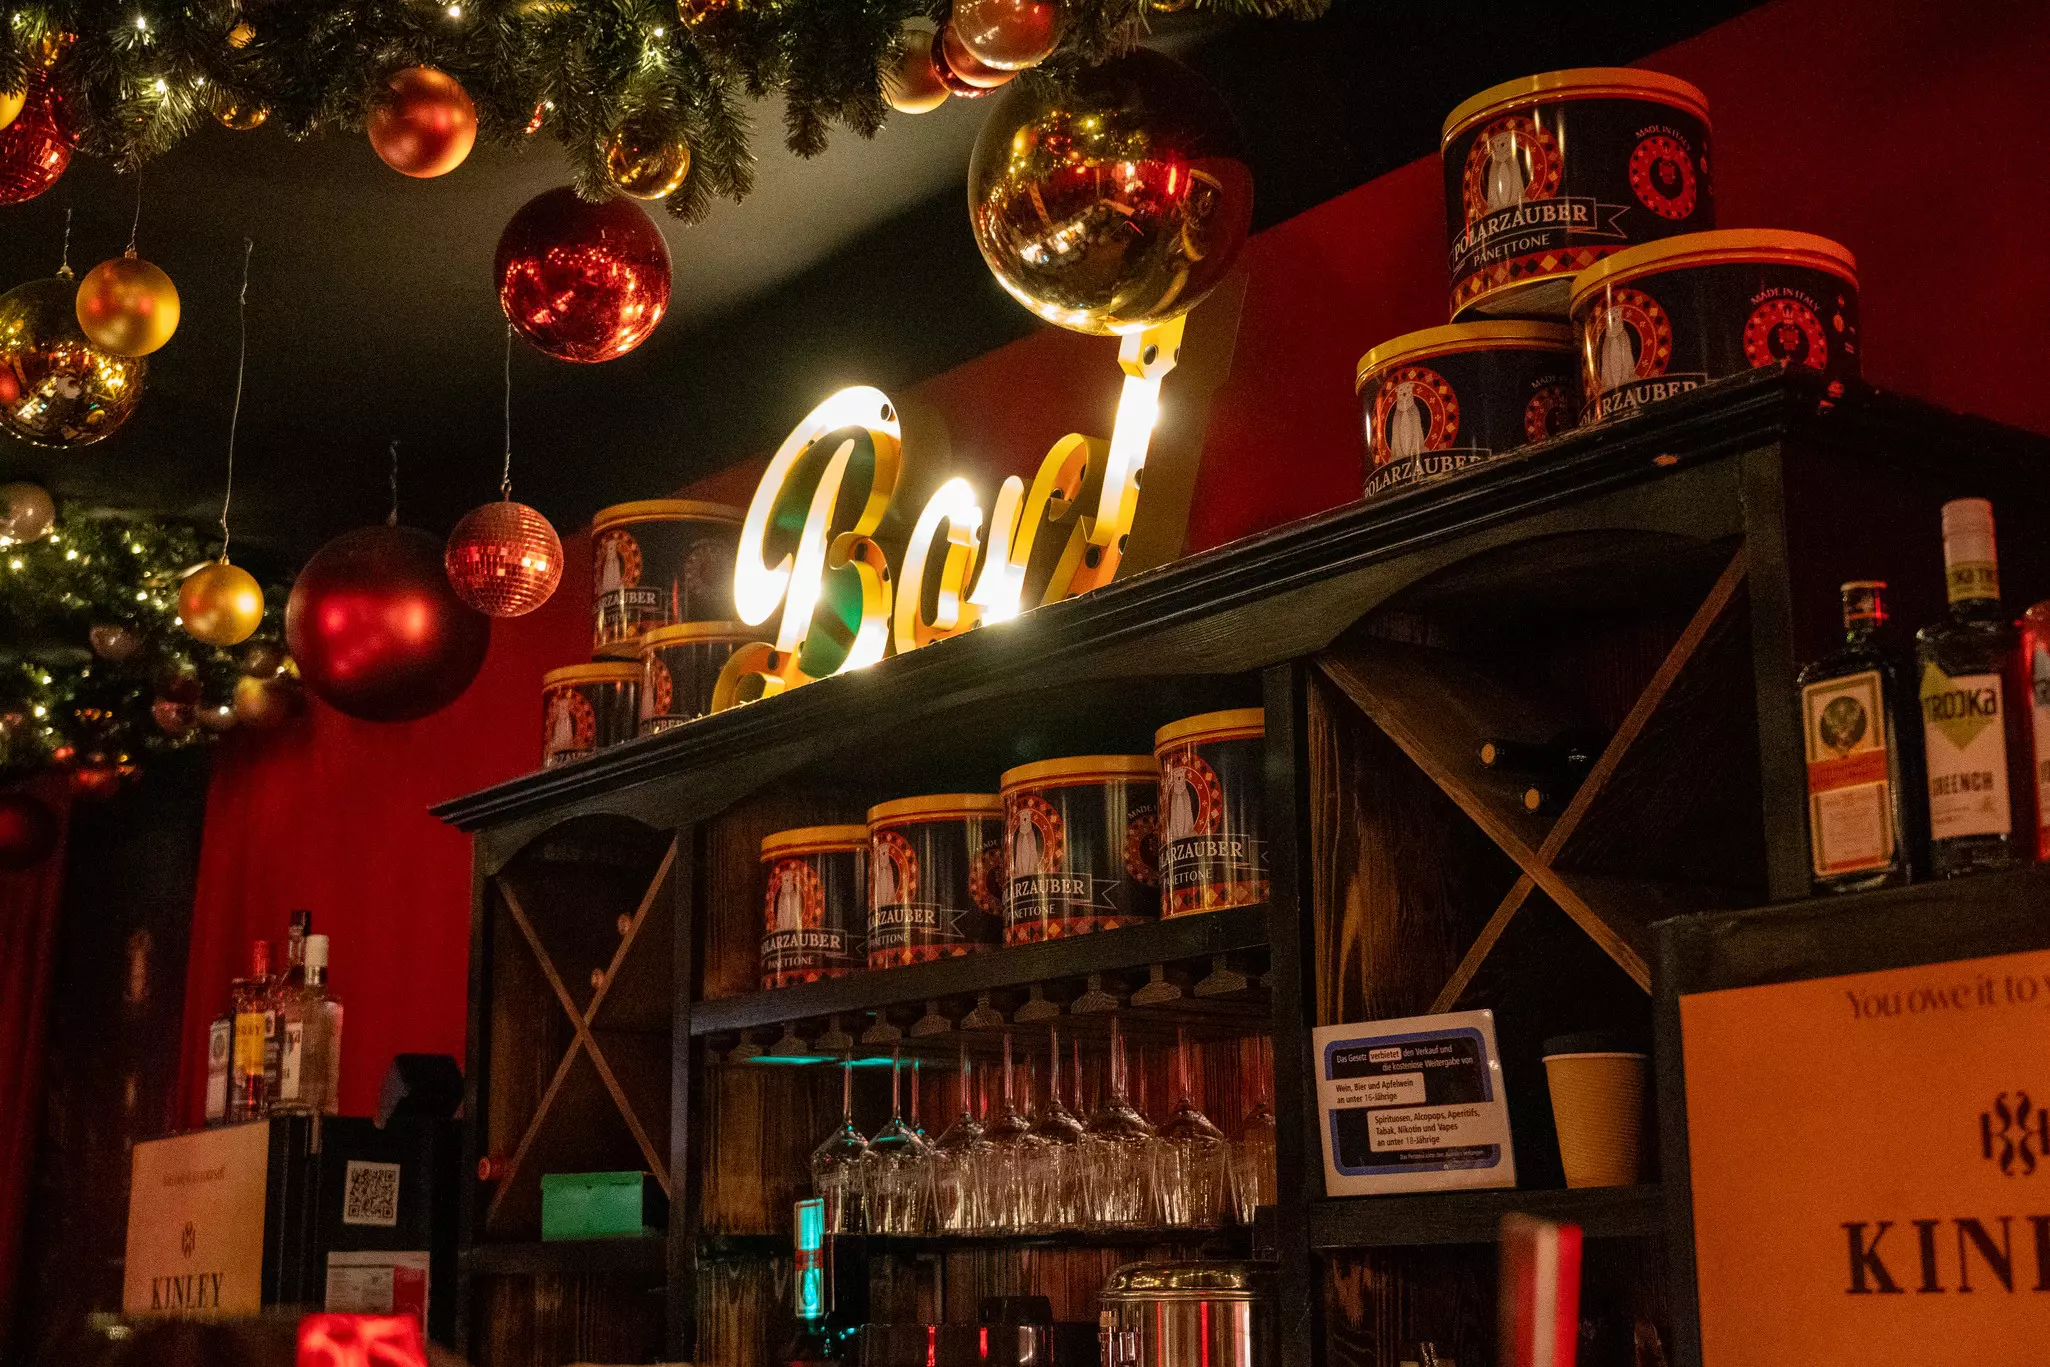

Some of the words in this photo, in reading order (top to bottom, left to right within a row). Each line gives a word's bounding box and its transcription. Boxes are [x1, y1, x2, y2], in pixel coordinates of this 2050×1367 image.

[1453, 203, 1588, 261] POLARZAUBER
[1473, 233, 1551, 266] PANETTONE
[1750, 288, 1779, 305] MADE
[1782, 287, 1794, 297] IN
[1794, 290, 1821, 313] ITALY
[1127, 804, 1154, 819] MADE
[1847, 988, 1902, 1019] You
[1906, 984, 1971, 1014] owe
[1974, 973, 1999, 1006] it
[2006, 974, 2039, 1004] to
[1336, 1055, 1347, 1064] Das
[1348, 1053, 1367, 1063] Gesetz
[1370, 1050, 1400, 1060] verbietet
[1402, 1047, 1414, 1057] den
[1415, 1044, 1439, 1056] Verkauf
[1440, 1044, 1453, 1053] und
[1382, 1062, 1392, 1072] die
[1392, 1060, 1424, 1071] kostenlose
[1424, 1057, 1460, 1069] Weitergabe
[1461, 1057, 1474, 1065] von
[1335, 1083, 1353, 1093] Wein,
[1354, 1082, 1367, 1091] Bier
[1367, 1080, 1381, 1090] und
[1382, 1079, 1414, 1090] Apfelwein
[1346, 1094, 1363, 1104] unter
[1374, 1114, 1413, 1125] Spirituosen,
[1413, 1111, 1447, 1122] Alcopops,
[1447, 1107, 1480, 1119] Aperitifs,
[1375, 1126, 1396, 1136] Tabak,
[1397, 1124, 1422, 1134] Nikotin
[1422, 1123, 1436, 1132] und
[1437, 1122, 1458, 1132] Vapes
[1377, 1139, 1386, 1147] an
[1386, 1137, 1404, 1146] unter
